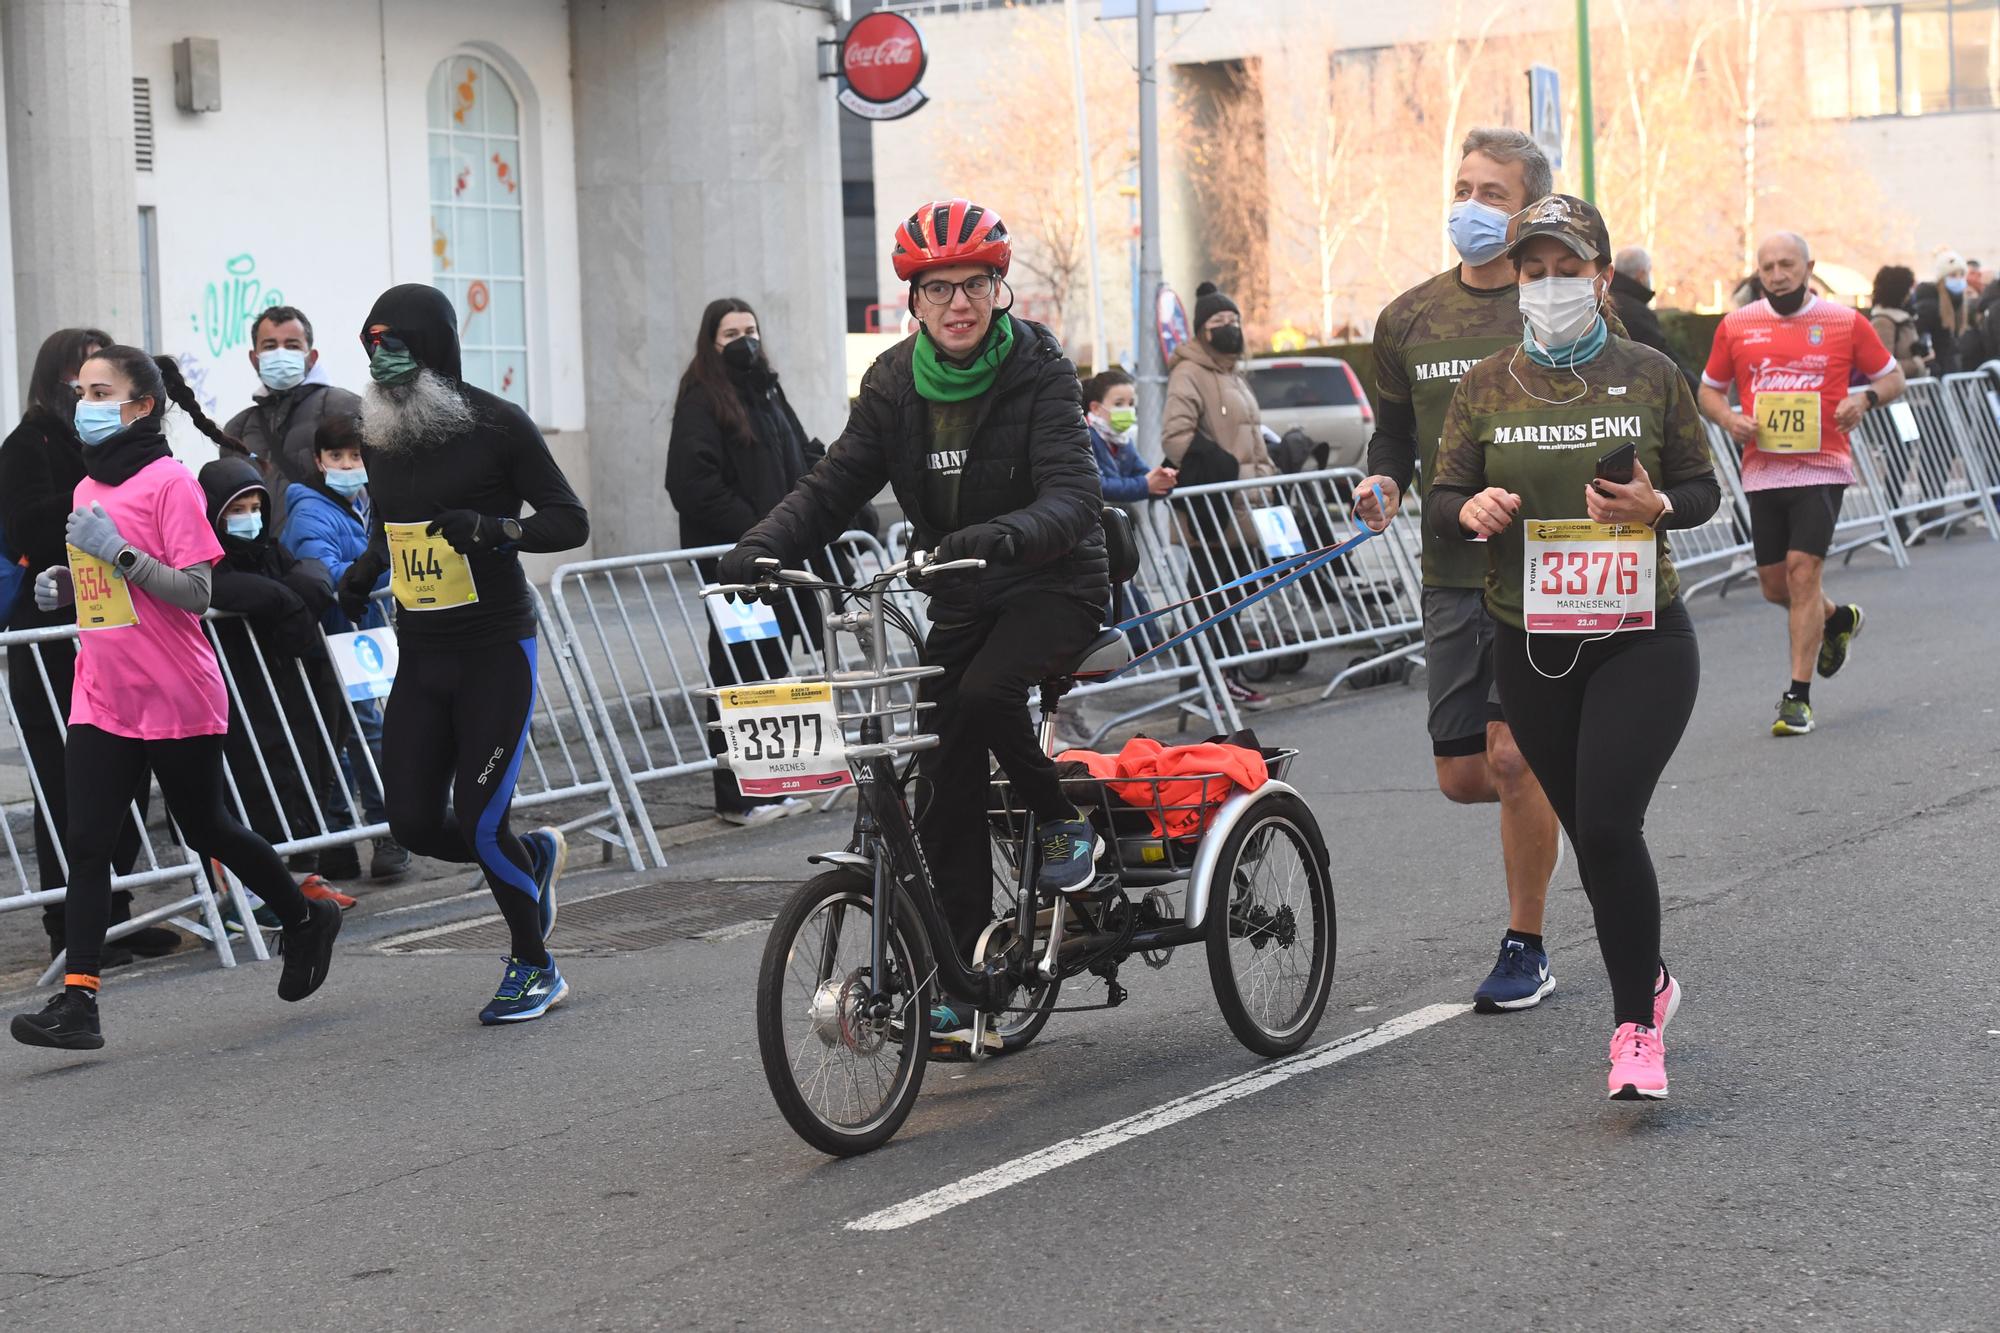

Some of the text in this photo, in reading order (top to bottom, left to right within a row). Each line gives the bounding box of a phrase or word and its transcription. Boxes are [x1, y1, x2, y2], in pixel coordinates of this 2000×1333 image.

[844, 37, 914, 70] Coca-Cola
[842, 92, 877, 114] CANDY
[1493, 416, 1641, 444] MARINES ENKI
[1767, 410, 1805, 433] 478
[402, 547, 443, 582] 144
[1541, 552, 1638, 595] 3376
[78, 566, 112, 601] 554
[1556, 600, 1621, 609] MARINESENKI
[728, 726, 739, 752] TANDA
[738, 714, 822, 761] 3377
[769, 762, 807, 773] MARINES
